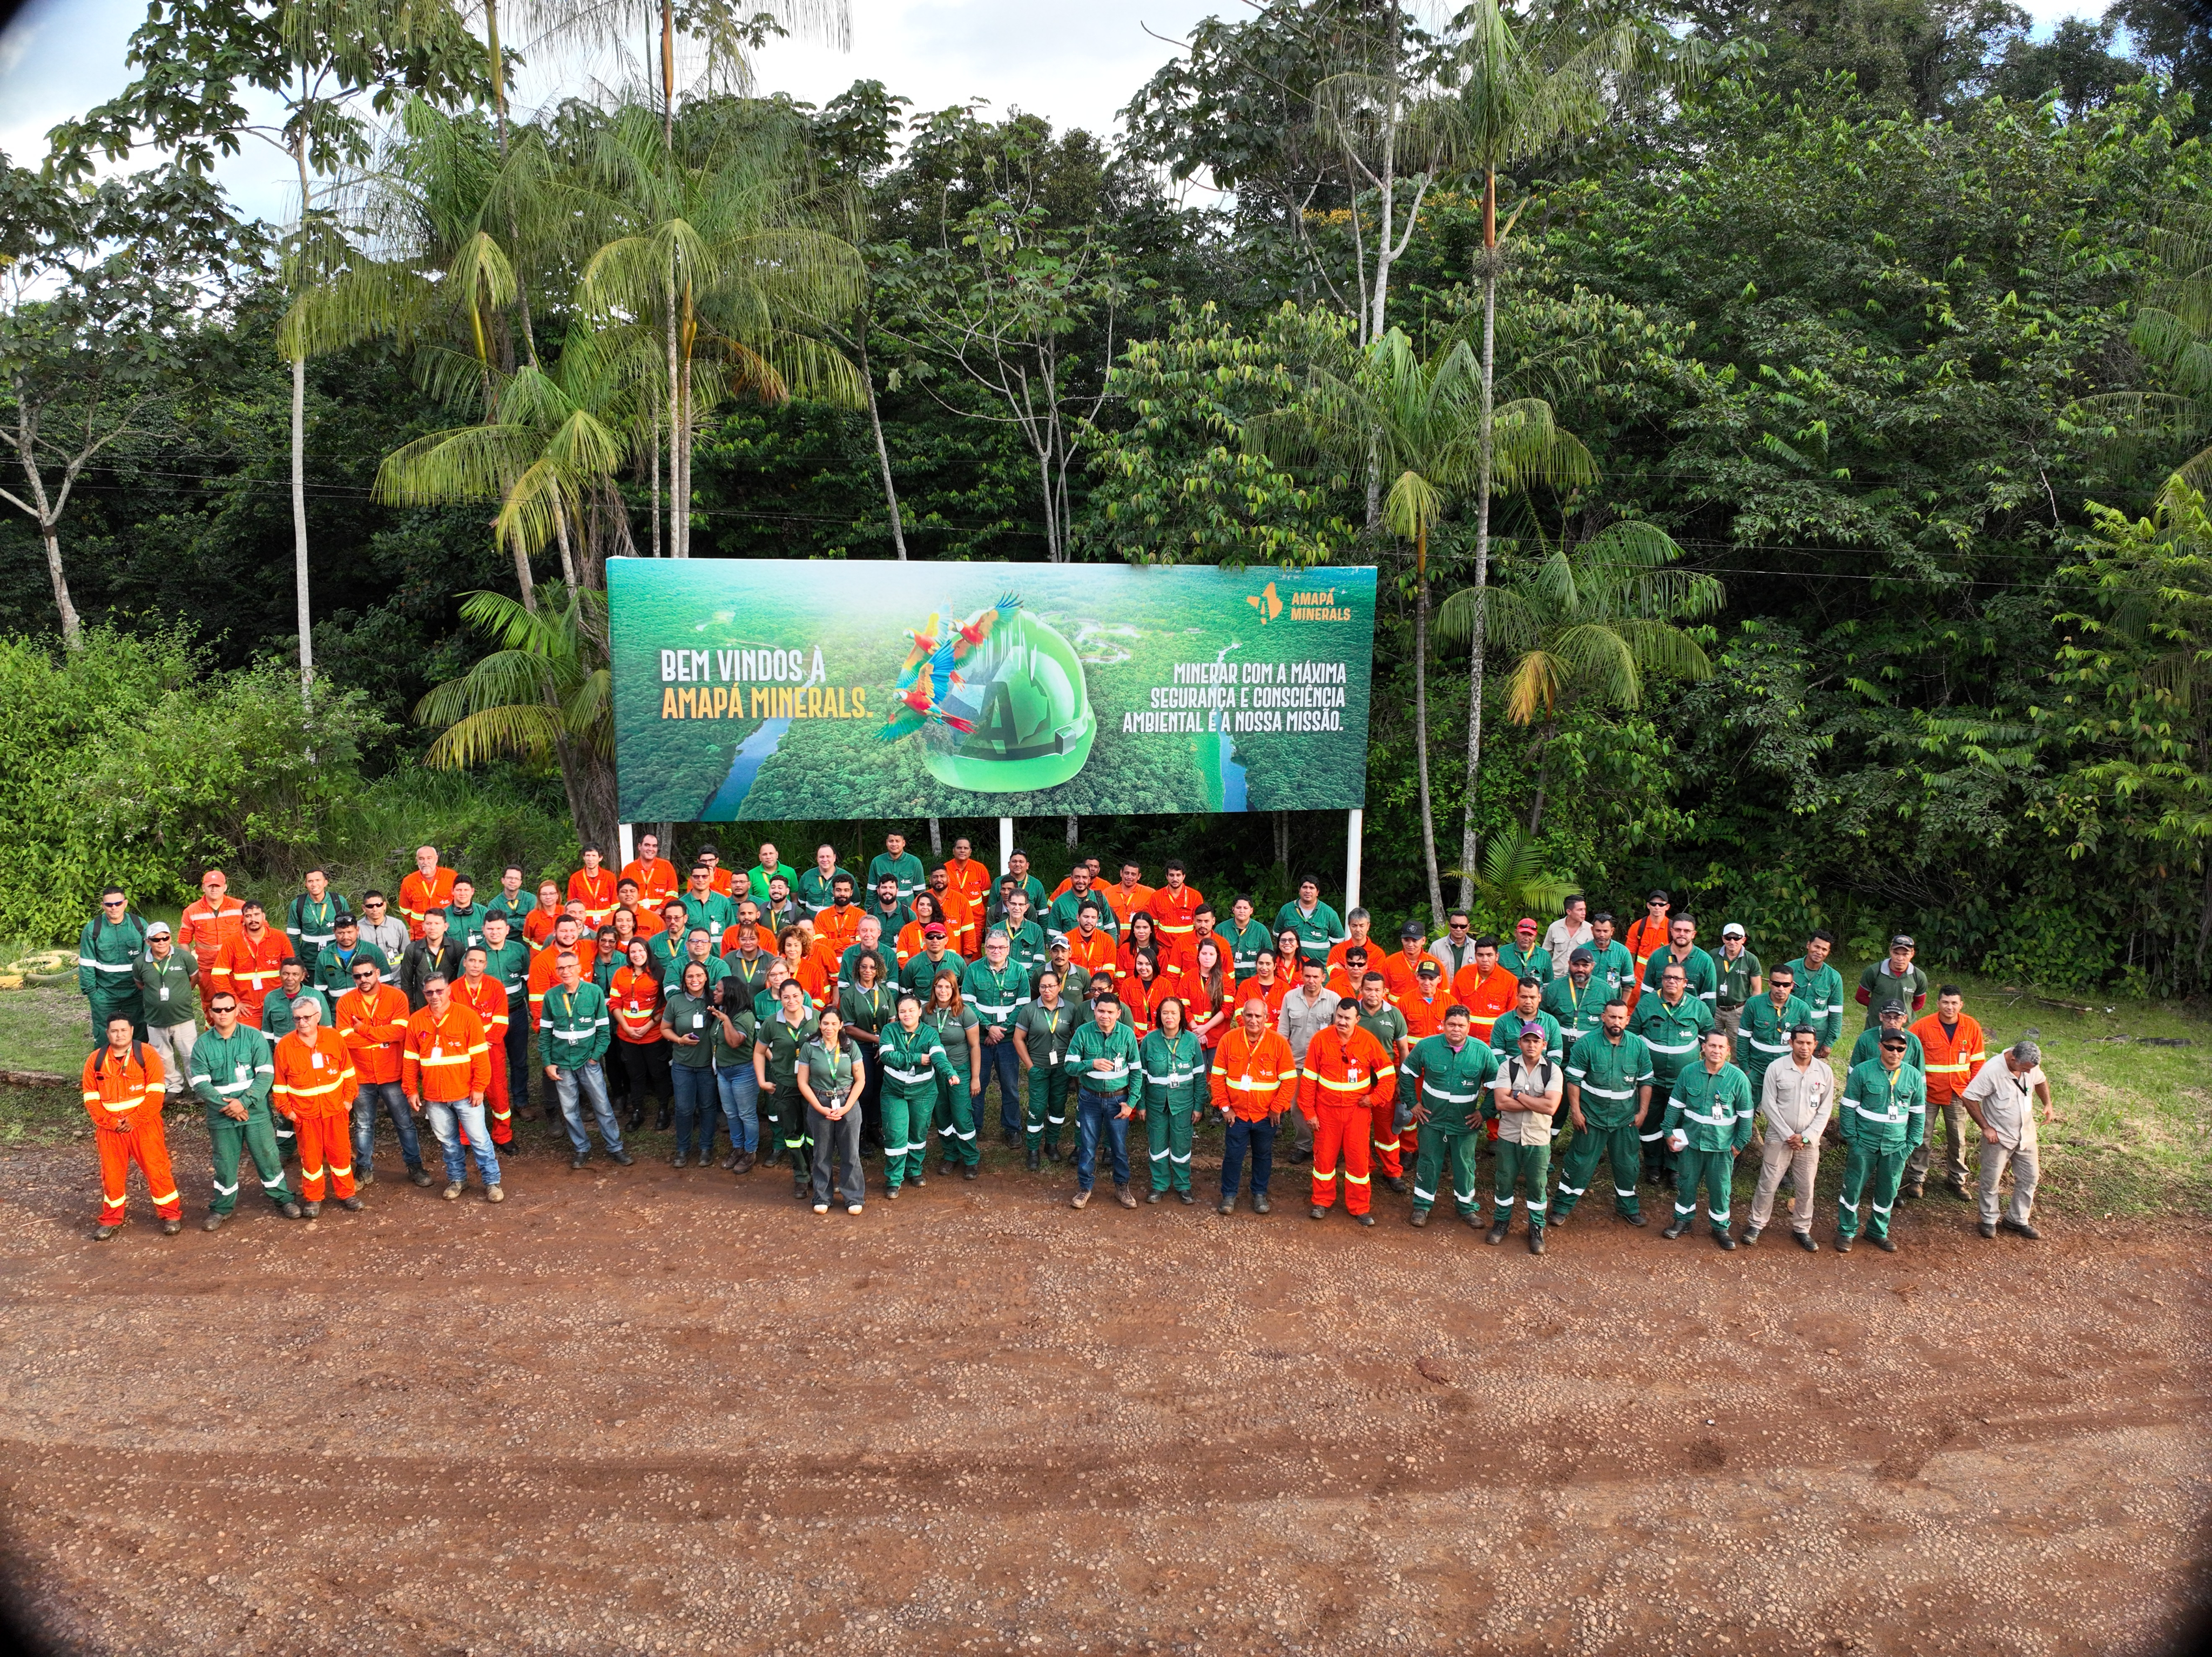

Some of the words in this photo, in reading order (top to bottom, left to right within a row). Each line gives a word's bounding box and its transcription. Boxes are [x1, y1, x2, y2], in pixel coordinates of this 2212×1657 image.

[1291, 587, 1335, 605] AMAPÁ
[1291, 608, 1351, 620] MINERALS
[662, 650, 709, 681] BEM
[717, 650, 802, 681] VINDOS
[811, 645, 826, 681] À
[1174, 663, 1237, 684] MINERAR
[1243, 663, 1272, 684] COM
[1277, 663, 1286, 684] A
[1291, 660, 1346, 684] MÁXIMA
[662, 682, 744, 719] AMAPÁ
[752, 687, 873, 718] MINERALS.
[1151, 687, 1236, 711] SEGURANÇA
[1240, 687, 1249, 707] E
[1253, 684, 1345, 707] CONSCIÊNCIA
[1123, 712, 1204, 732] AMBIENTAL
[1208, 708, 1217, 732] É
[1220, 712, 1231, 732] A
[1235, 711, 1282, 732] NOSSA
[1286, 708, 1344, 731] MISSÃO.
